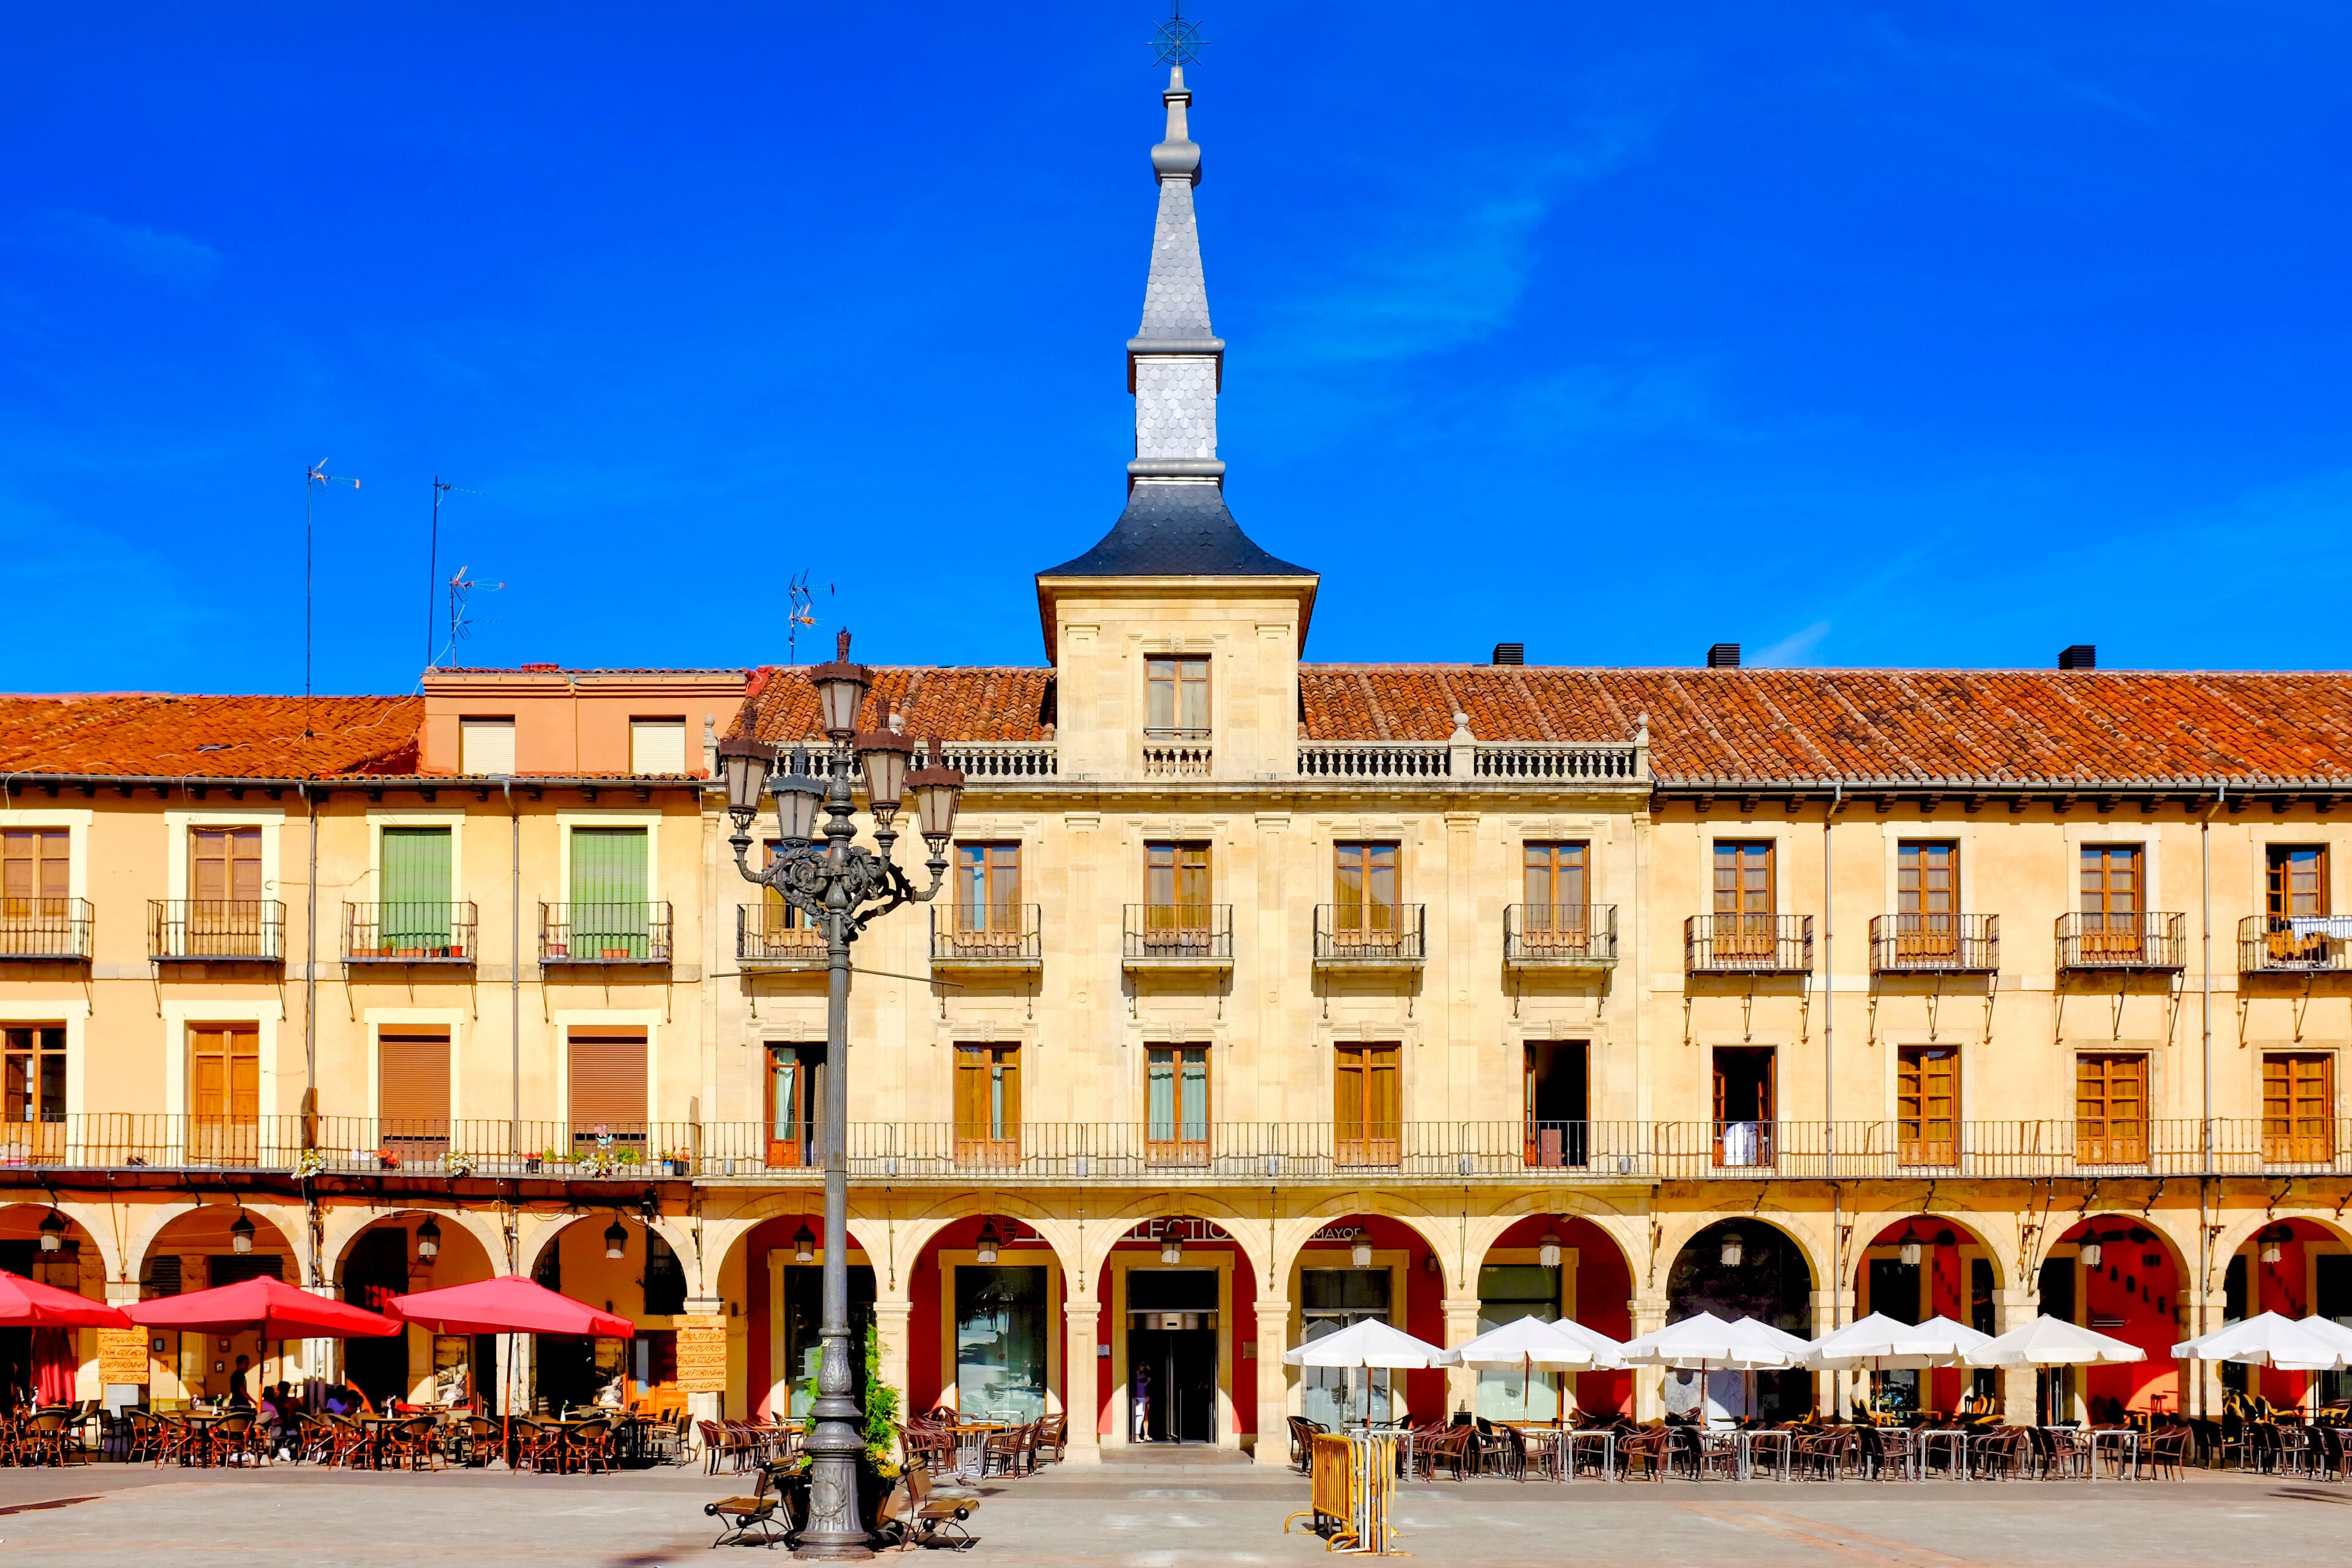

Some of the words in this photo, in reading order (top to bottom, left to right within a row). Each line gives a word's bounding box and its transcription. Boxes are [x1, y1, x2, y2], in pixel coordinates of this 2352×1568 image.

[98, 1347, 115, 1356] PIÑA
[697, 1355, 726, 1364] COLADA
[679, 1368, 725, 1377] CAIPIRINHA
